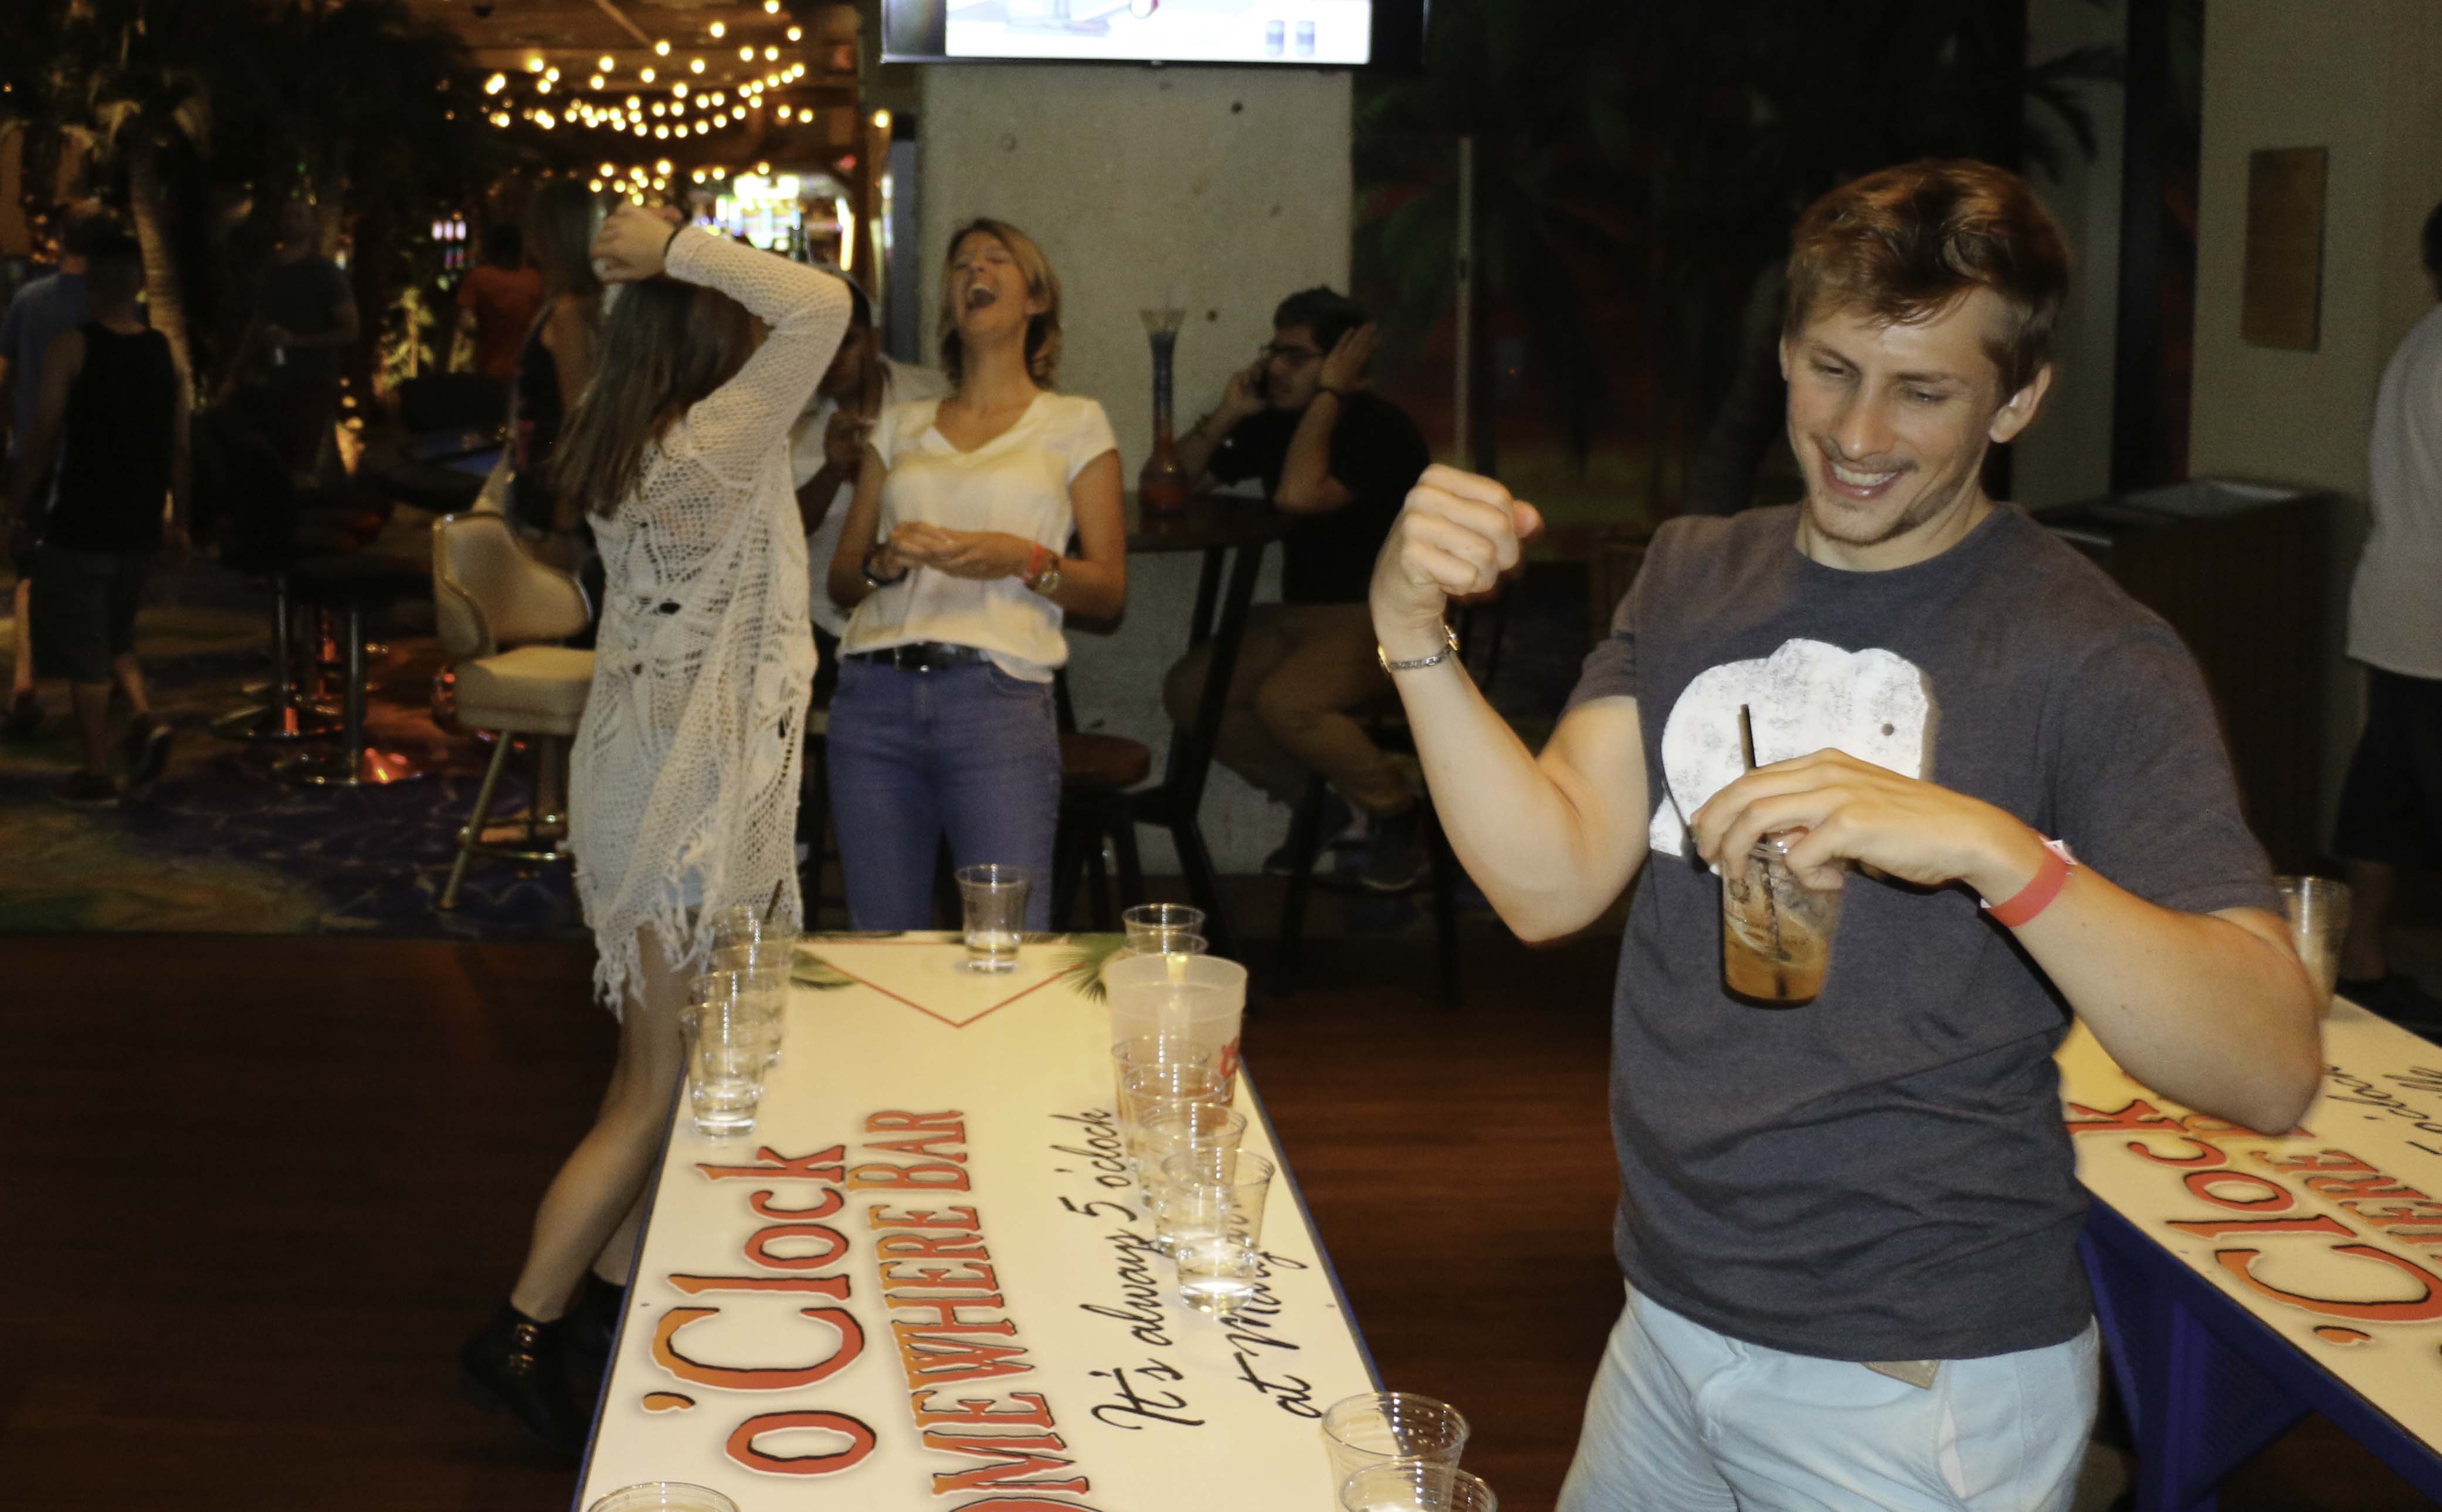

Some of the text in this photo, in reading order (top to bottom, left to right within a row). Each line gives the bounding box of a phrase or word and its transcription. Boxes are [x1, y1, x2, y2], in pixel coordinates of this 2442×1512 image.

[848, 1110, 1103, 1512] MEWHERE BAR
[1047, 1108, 1205, 1431] It's always 5 o'clock
[2064, 1099, 2442, 1355] 'Clock
[1234, 1351, 1322, 1419] at
